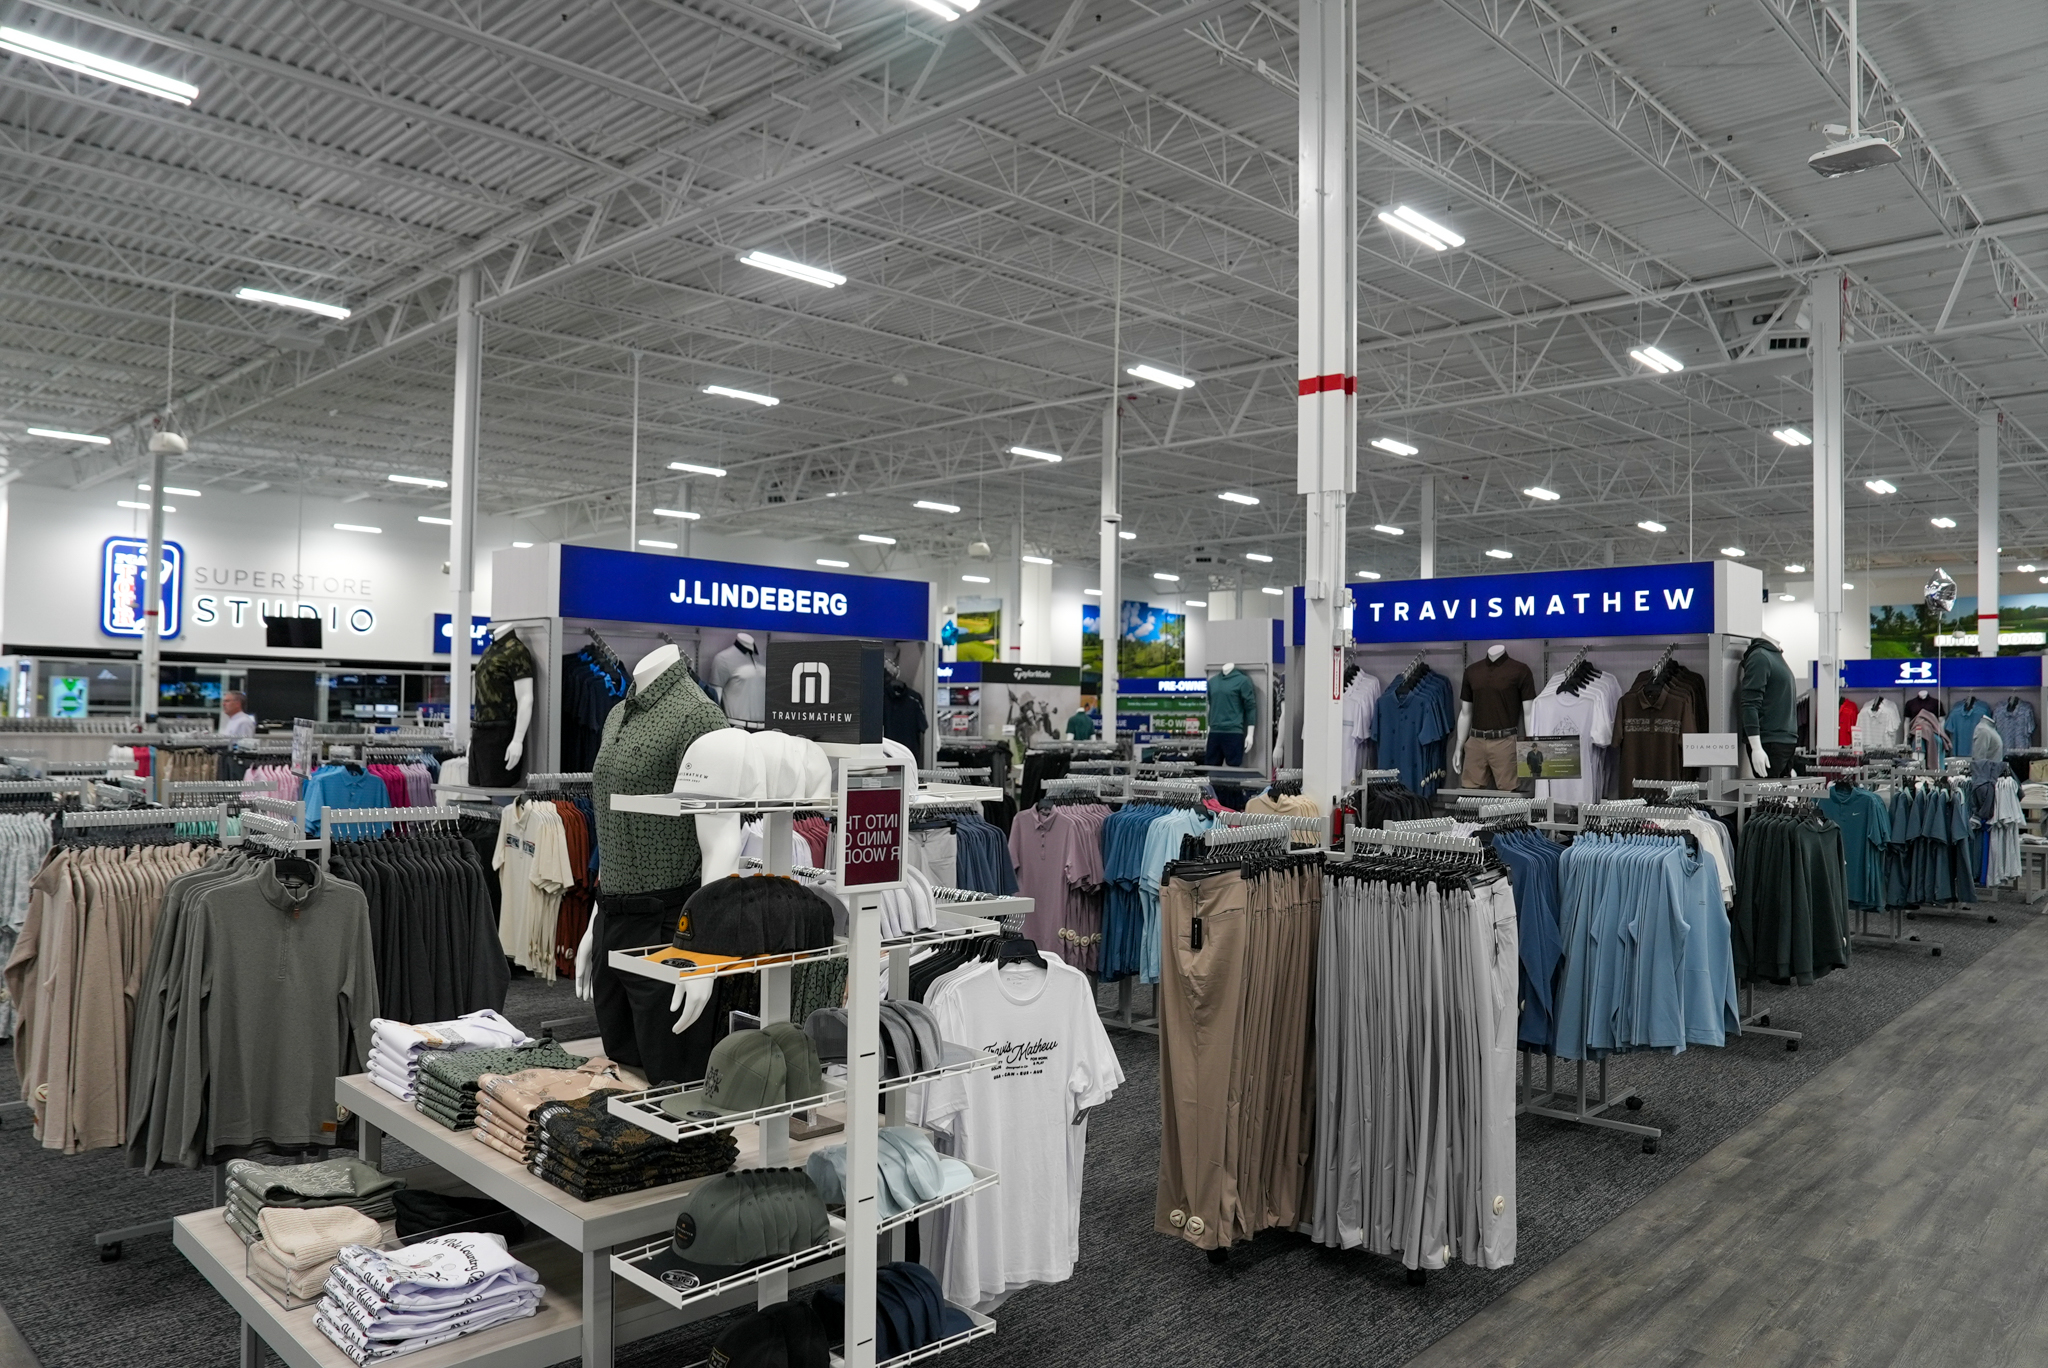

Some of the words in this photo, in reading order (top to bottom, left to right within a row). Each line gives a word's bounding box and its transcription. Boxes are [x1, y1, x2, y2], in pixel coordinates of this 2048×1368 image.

[194, 566, 372, 596] SUPERSTORE
[669, 578, 848, 617] J.LINDEBERG
[1369, 587, 1695, 622] TRAVISMATHEW
[1998, 632, 2045, 646] OOMS
[1158, 681, 1207, 691] PRE-OWNE
[772, 711, 853, 723] TRAVISMATHEW
[1006, 1037, 1058, 1065] Mathew
